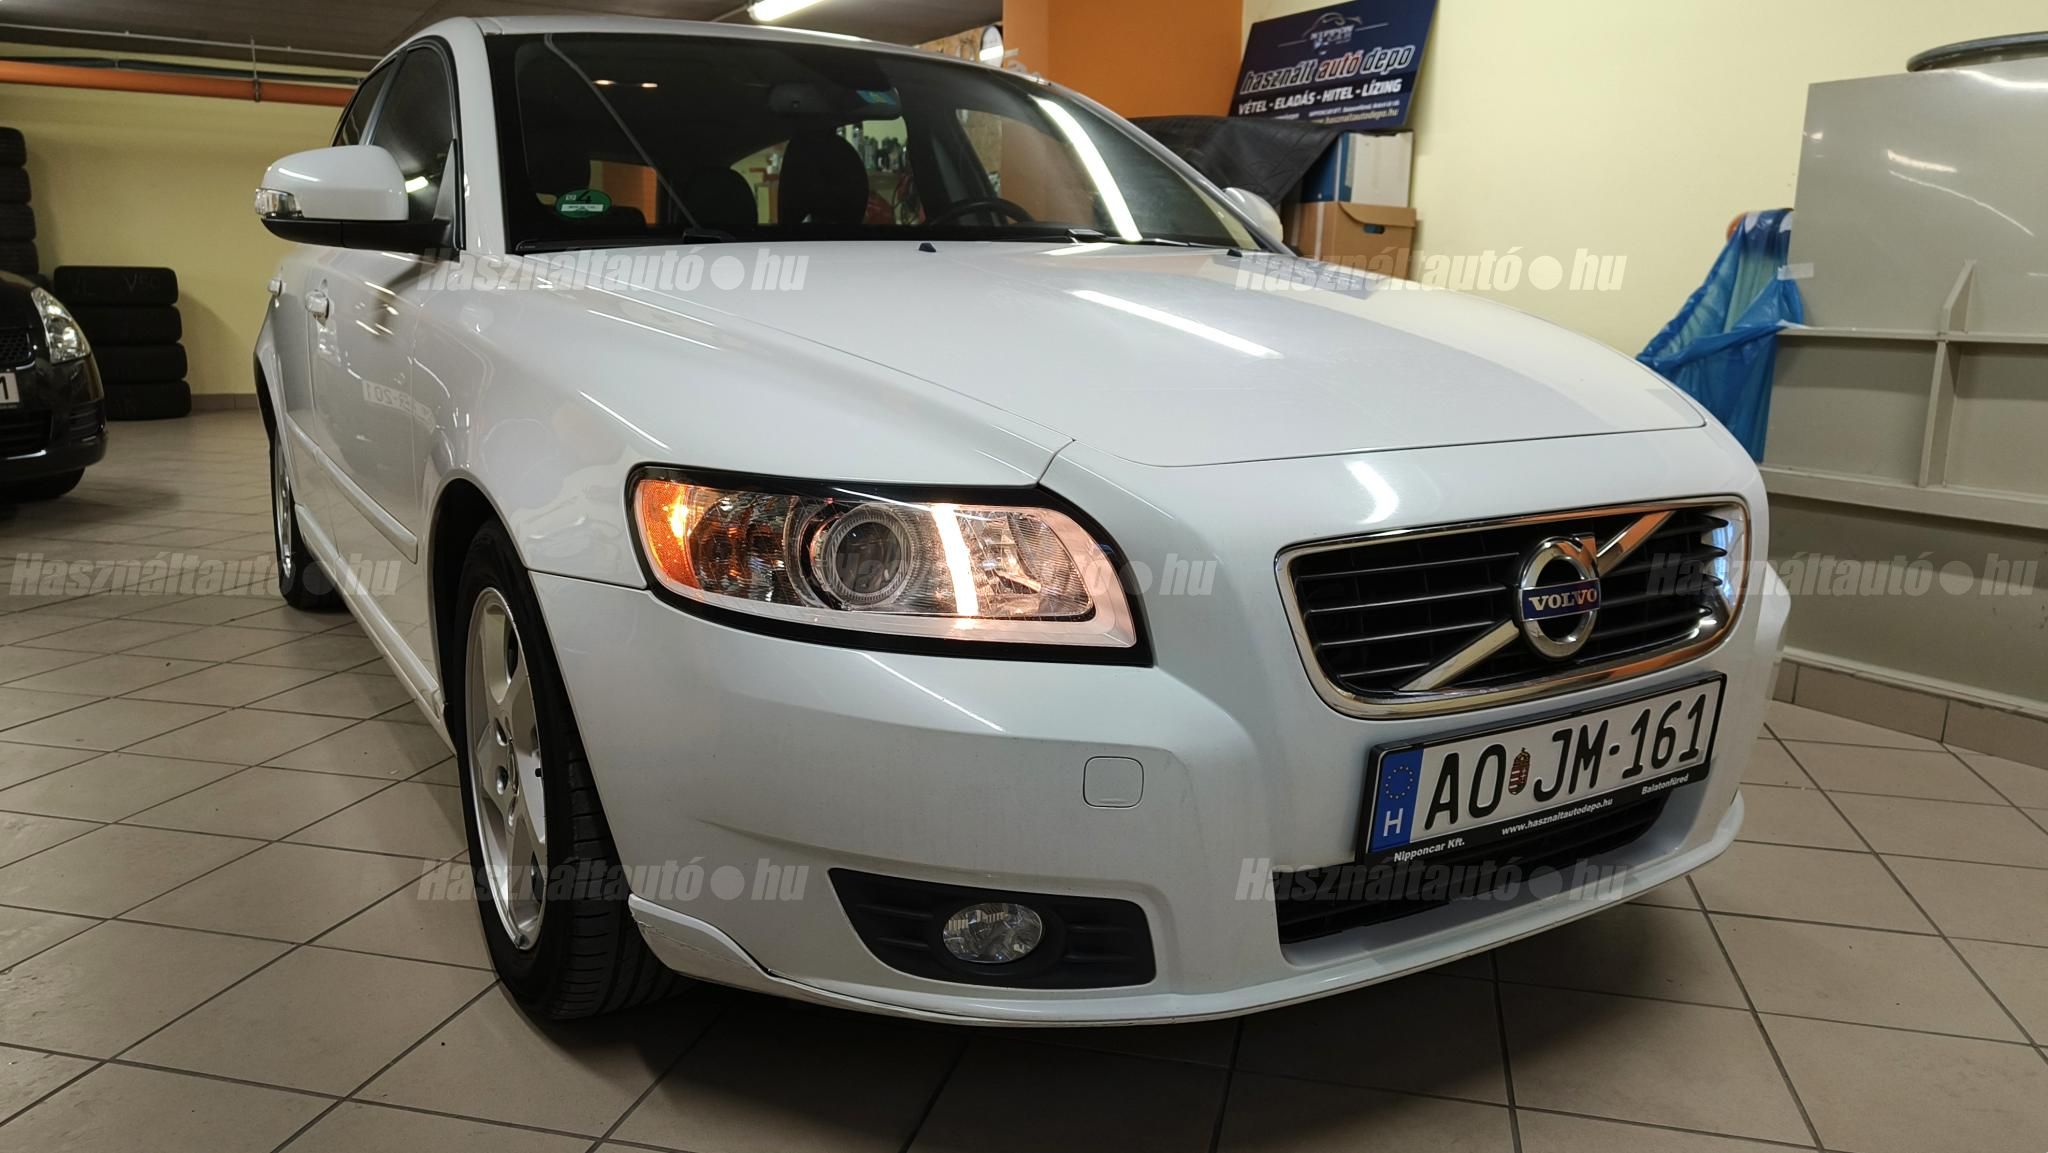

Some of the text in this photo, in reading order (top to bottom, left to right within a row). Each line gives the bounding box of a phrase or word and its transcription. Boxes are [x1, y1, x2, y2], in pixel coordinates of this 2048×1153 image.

[1240, 45, 1415, 95] használt autó depo
[1238, 100, 1267, 115] VÉTEL
[1274, 90, 1316, 110] ELADÁS
[1322, 86, 1354, 102] HITEL
[1361, 78, 1402, 97] LÍZING
[1528, 588, 1598, 611] VOLVO
[1425, 694, 1707, 830] AO JM-161
[1641, 773, 1689, 795] Balatonfüred
[1383, 808, 1404, 837] H
[1502, 798, 1613, 835] www.hasznaltautodepo.hu
[1394, 837, 1465, 863] Nipponcar Kft.
